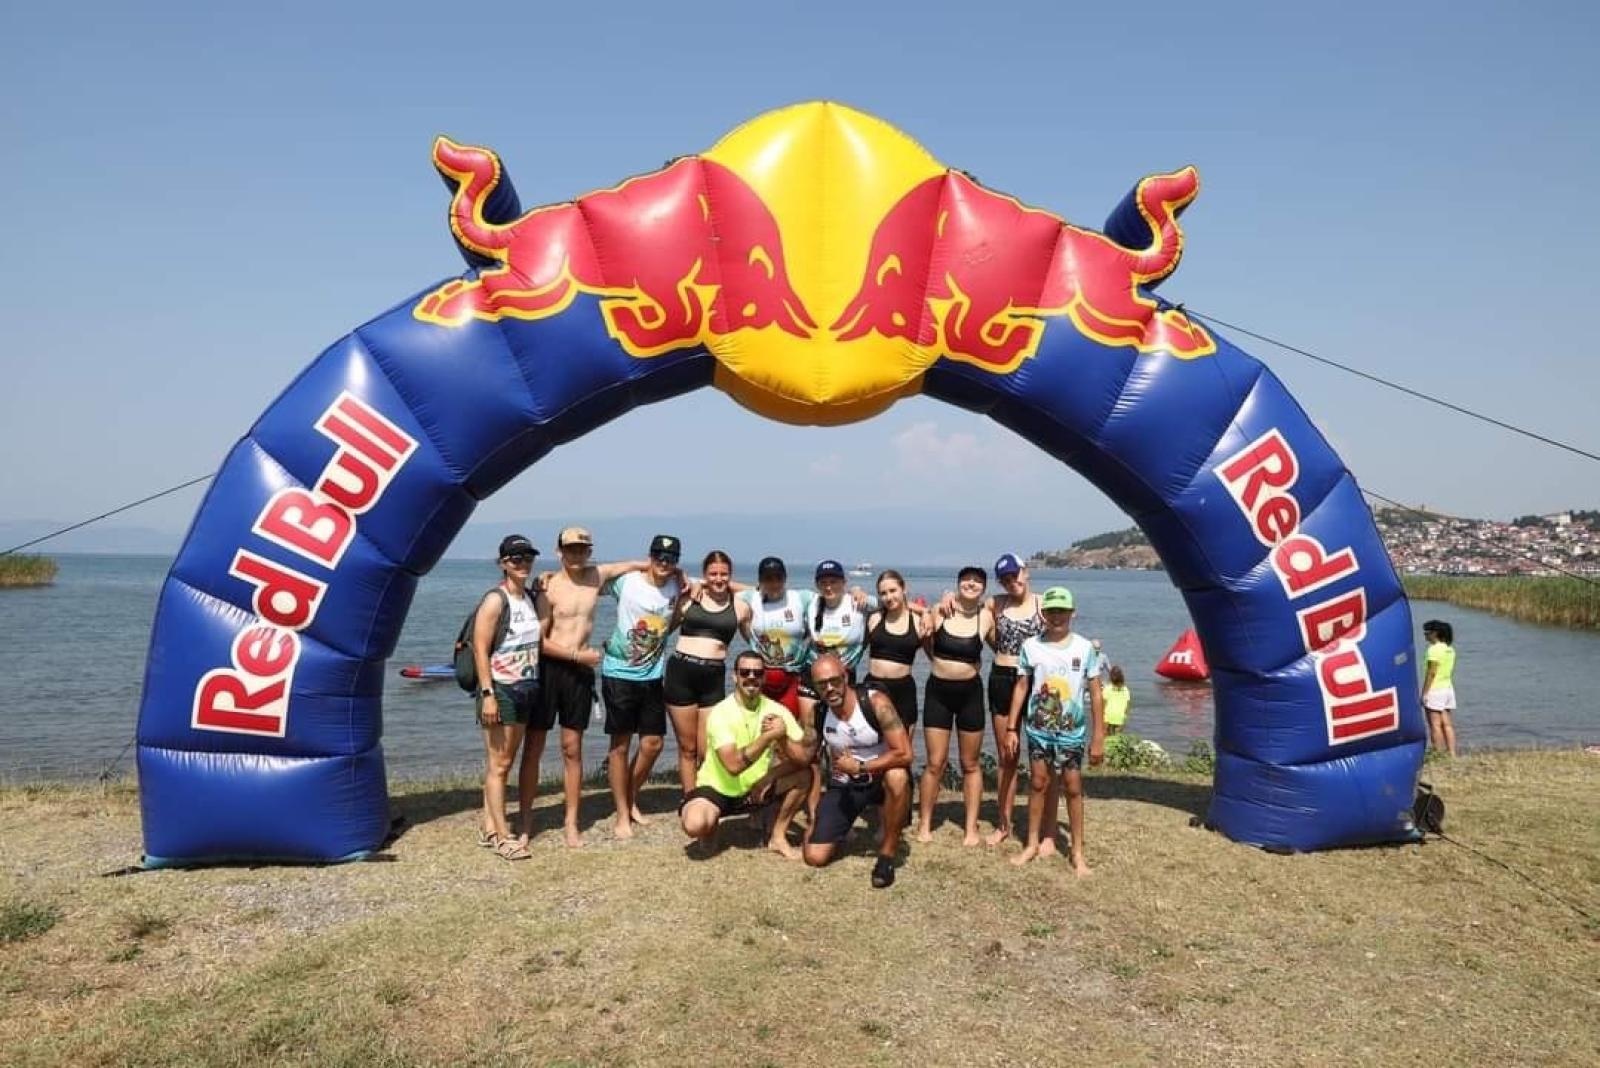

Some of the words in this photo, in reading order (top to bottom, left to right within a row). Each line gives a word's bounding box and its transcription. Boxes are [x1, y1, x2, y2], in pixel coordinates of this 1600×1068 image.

[252, 391, 419, 569] Bull
[191, 548, 328, 737] Red
[1213, 428, 1359, 599] Red
[1296, 588, 1399, 746] Bull
